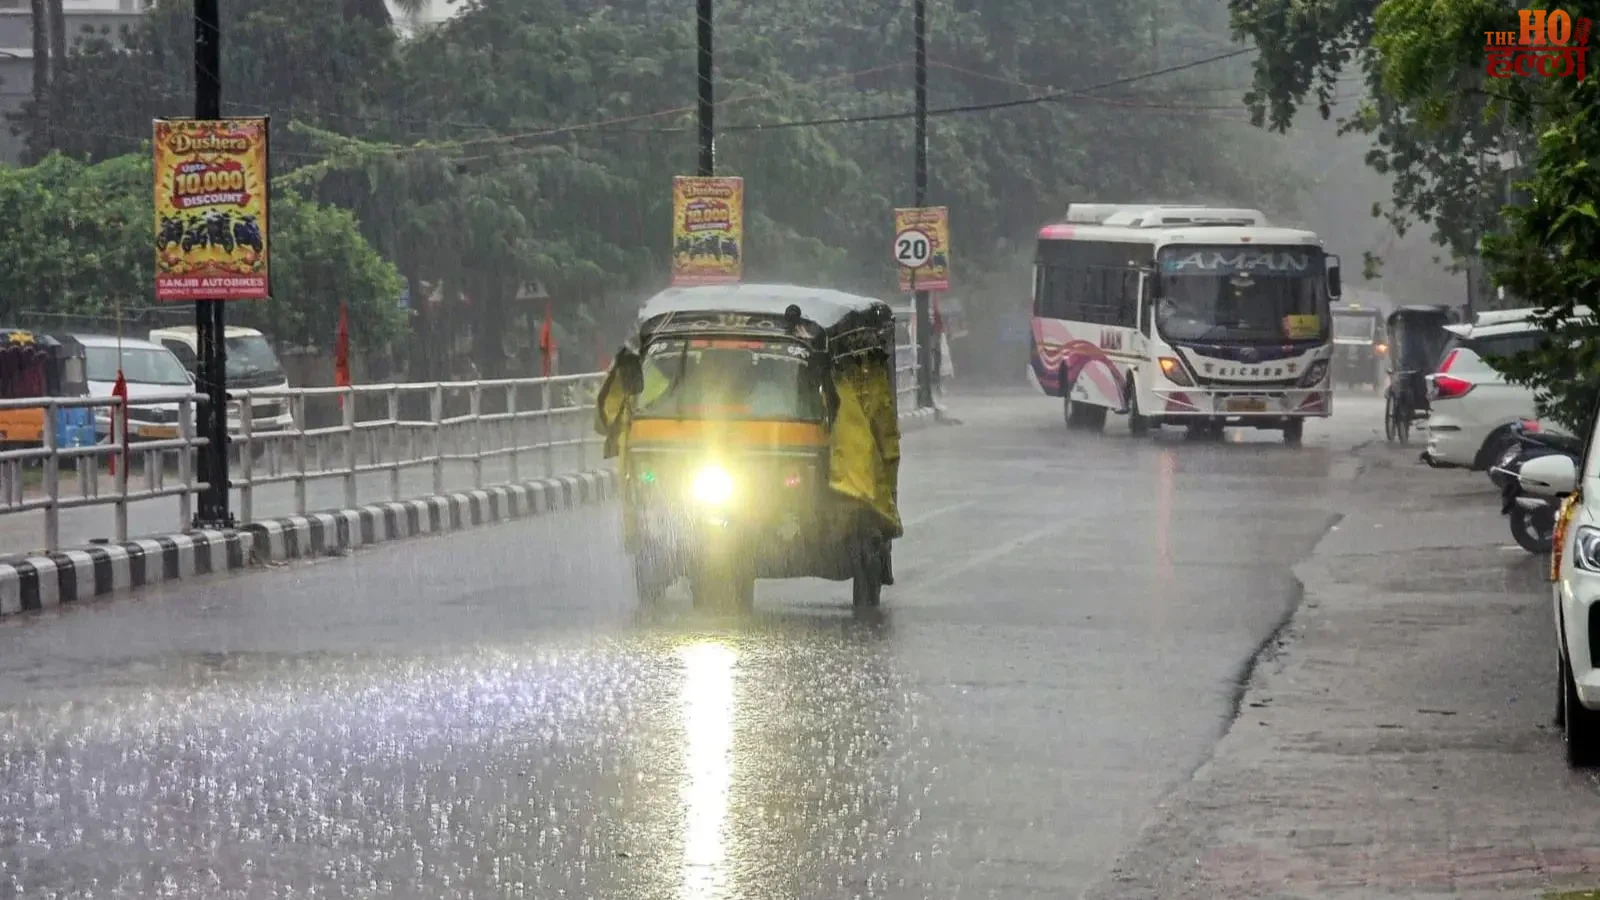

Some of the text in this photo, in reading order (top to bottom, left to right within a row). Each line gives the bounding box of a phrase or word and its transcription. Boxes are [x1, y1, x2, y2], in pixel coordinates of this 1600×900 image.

[170, 133, 247, 152] Dushera
[183, 193, 243, 206] DISCOUNT
[898, 240, 927, 260] 20
[1176, 252, 1309, 271] AMAN
[201, 277, 265, 287] AUTOBIKES
